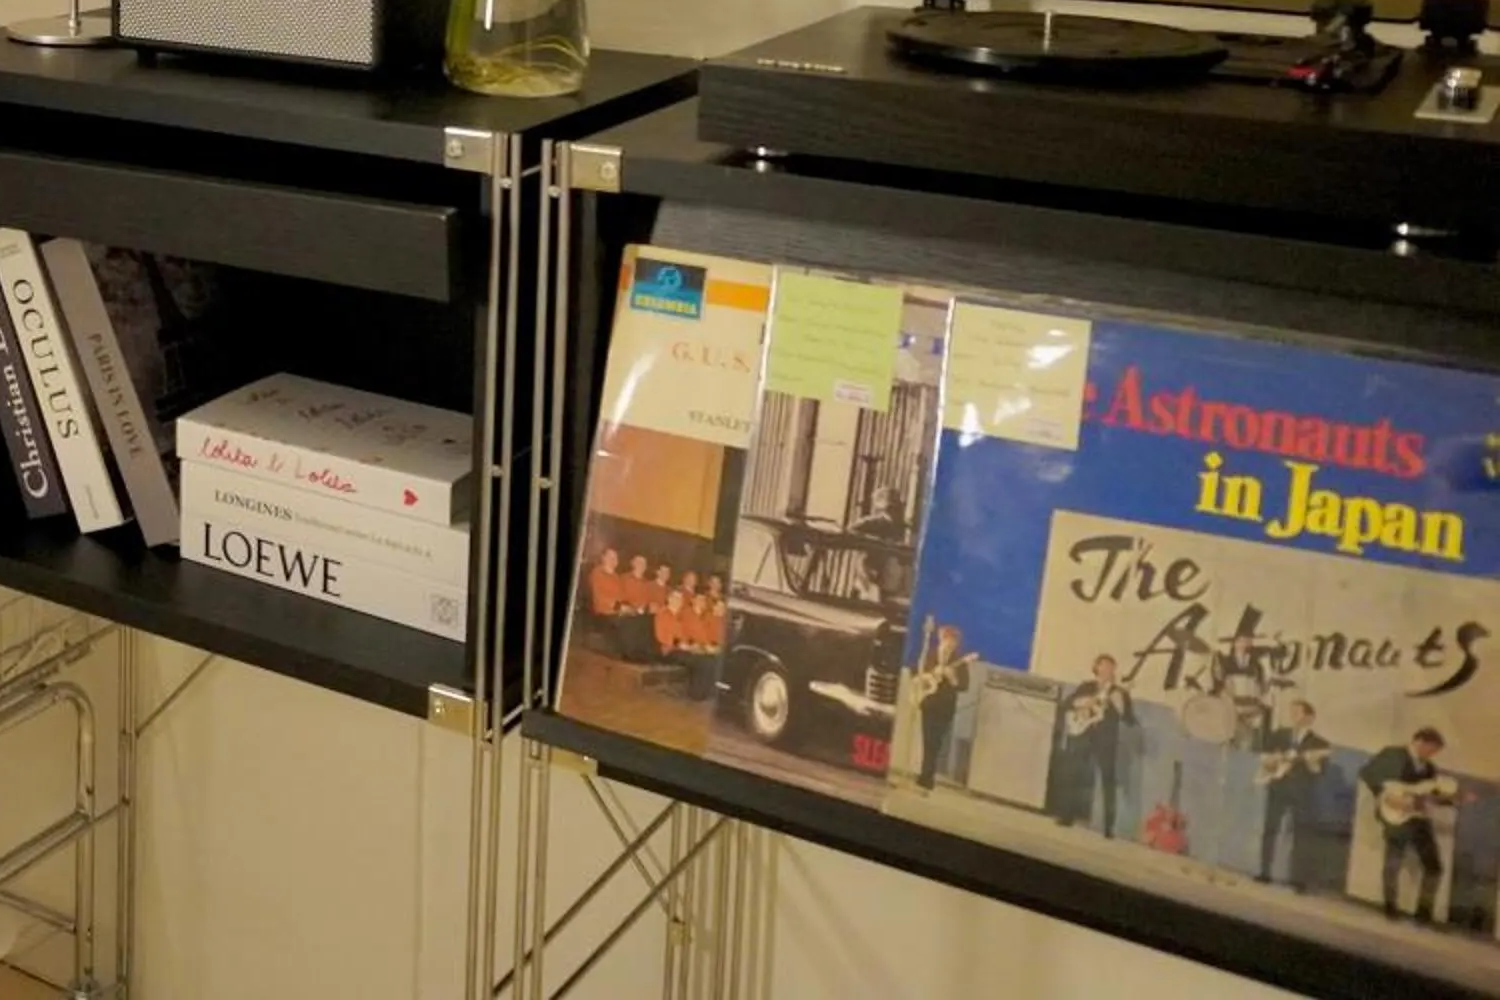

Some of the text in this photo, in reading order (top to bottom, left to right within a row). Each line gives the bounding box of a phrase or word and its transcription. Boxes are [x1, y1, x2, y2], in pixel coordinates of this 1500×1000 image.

[12, 279, 79, 440] OCULUS
[3, 364, 49, 498] Christian
[1102, 364, 1426, 478] Astronauts
[214, 489, 293, 521] LONGINES
[1194, 452, 1466, 561] in Japan
[203, 522, 343, 598] LOEWE
[1069, 535, 1213, 602] The
